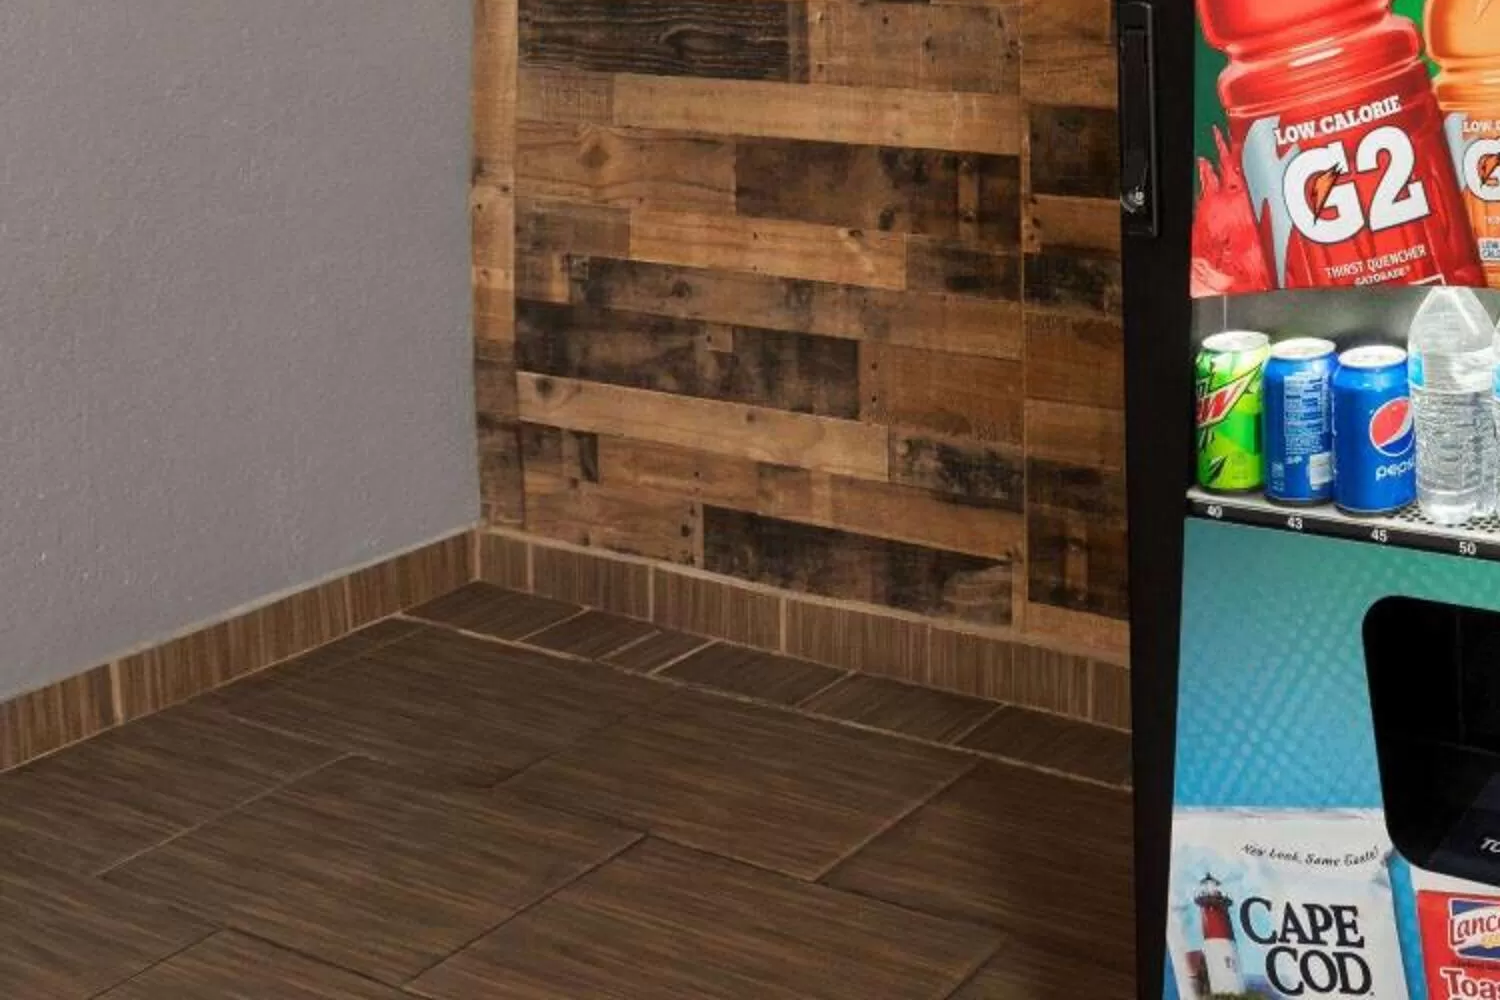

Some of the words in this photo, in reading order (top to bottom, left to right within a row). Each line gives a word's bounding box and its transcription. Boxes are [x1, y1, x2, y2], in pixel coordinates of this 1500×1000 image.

[1275, 121, 1317, 145] LOW
[1320, 95, 1402, 134] CALORIE
[1463, 119, 1495, 133] LOW
[1282, 125, 1431, 244] G2
[1324, 260, 1364, 279] THIRST
[1367, 244, 1428, 272] QUENCHER
[1375, 459, 1416, 481] peps
[1207, 504, 1223, 518] 40
[1287, 517, 1303, 530] 43
[1371, 529, 1388, 542] 45
[1459, 541, 1476, 555] 50
[1241, 843, 1266, 857] New
[1304, 852, 1340, 867] Same
[1239, 896, 1365, 948] CAPE
[1265, 946, 1373, 997] COD
